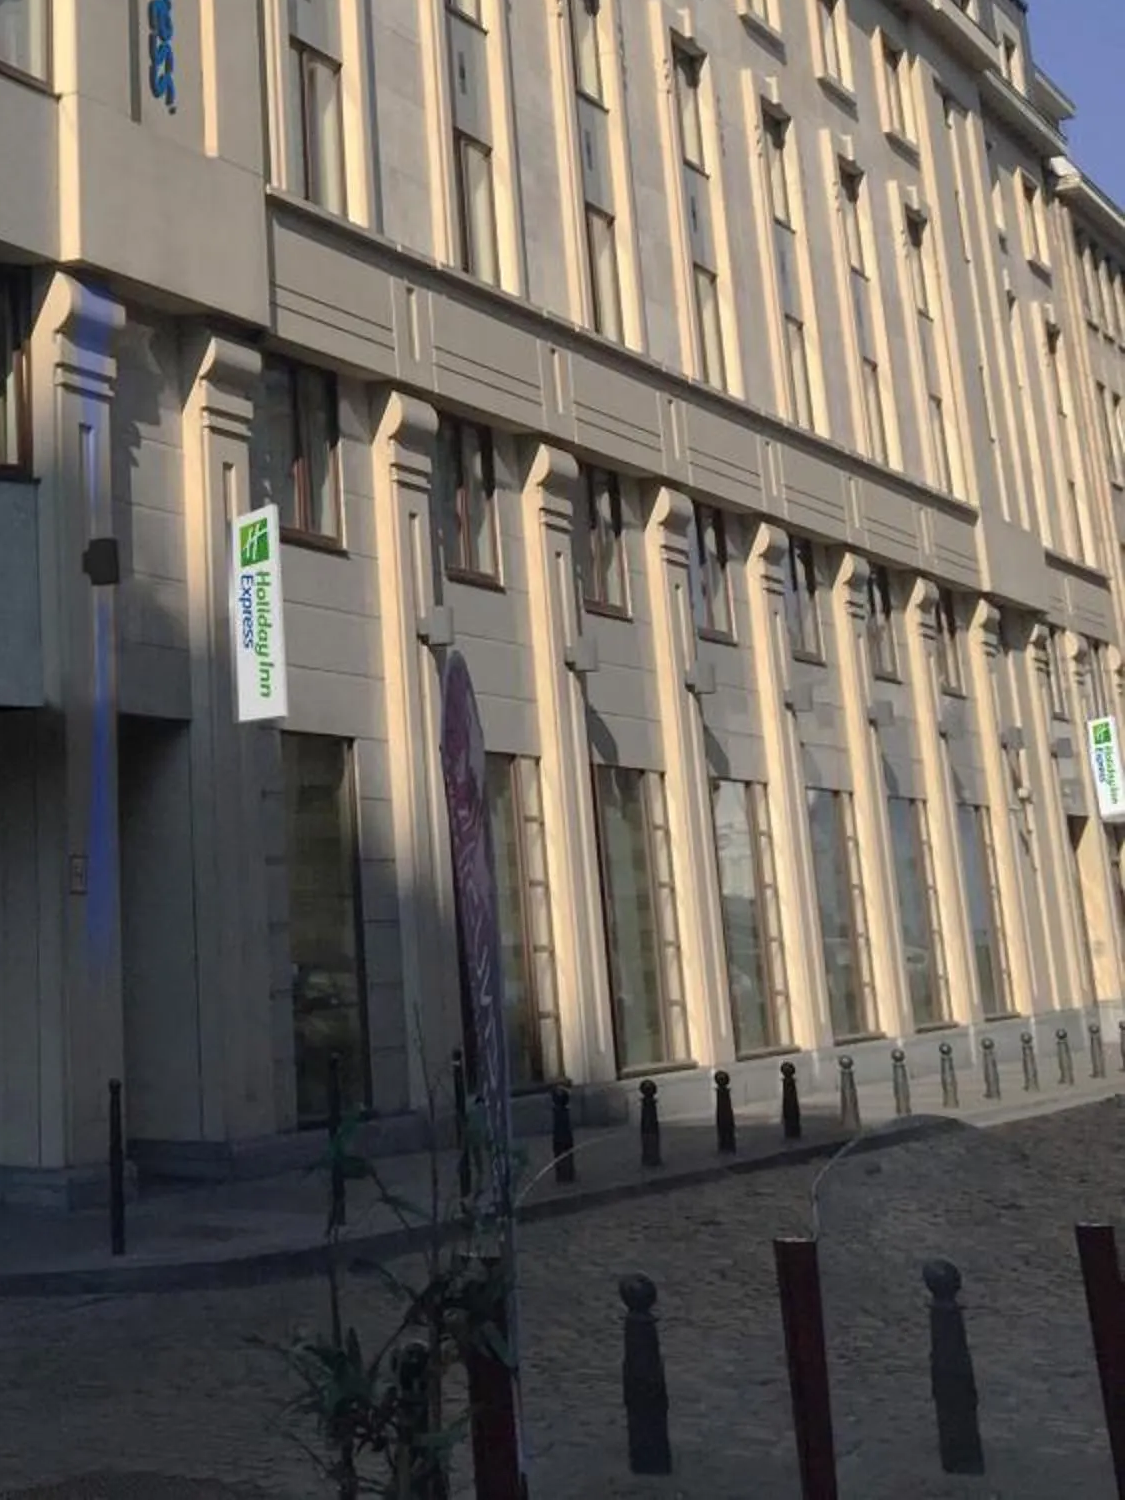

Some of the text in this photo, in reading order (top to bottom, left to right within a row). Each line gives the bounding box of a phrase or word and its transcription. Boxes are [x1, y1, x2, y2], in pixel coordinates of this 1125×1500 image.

[239, 574, 254, 649] Express
[255, 571, 274, 698] Holiday Inn
